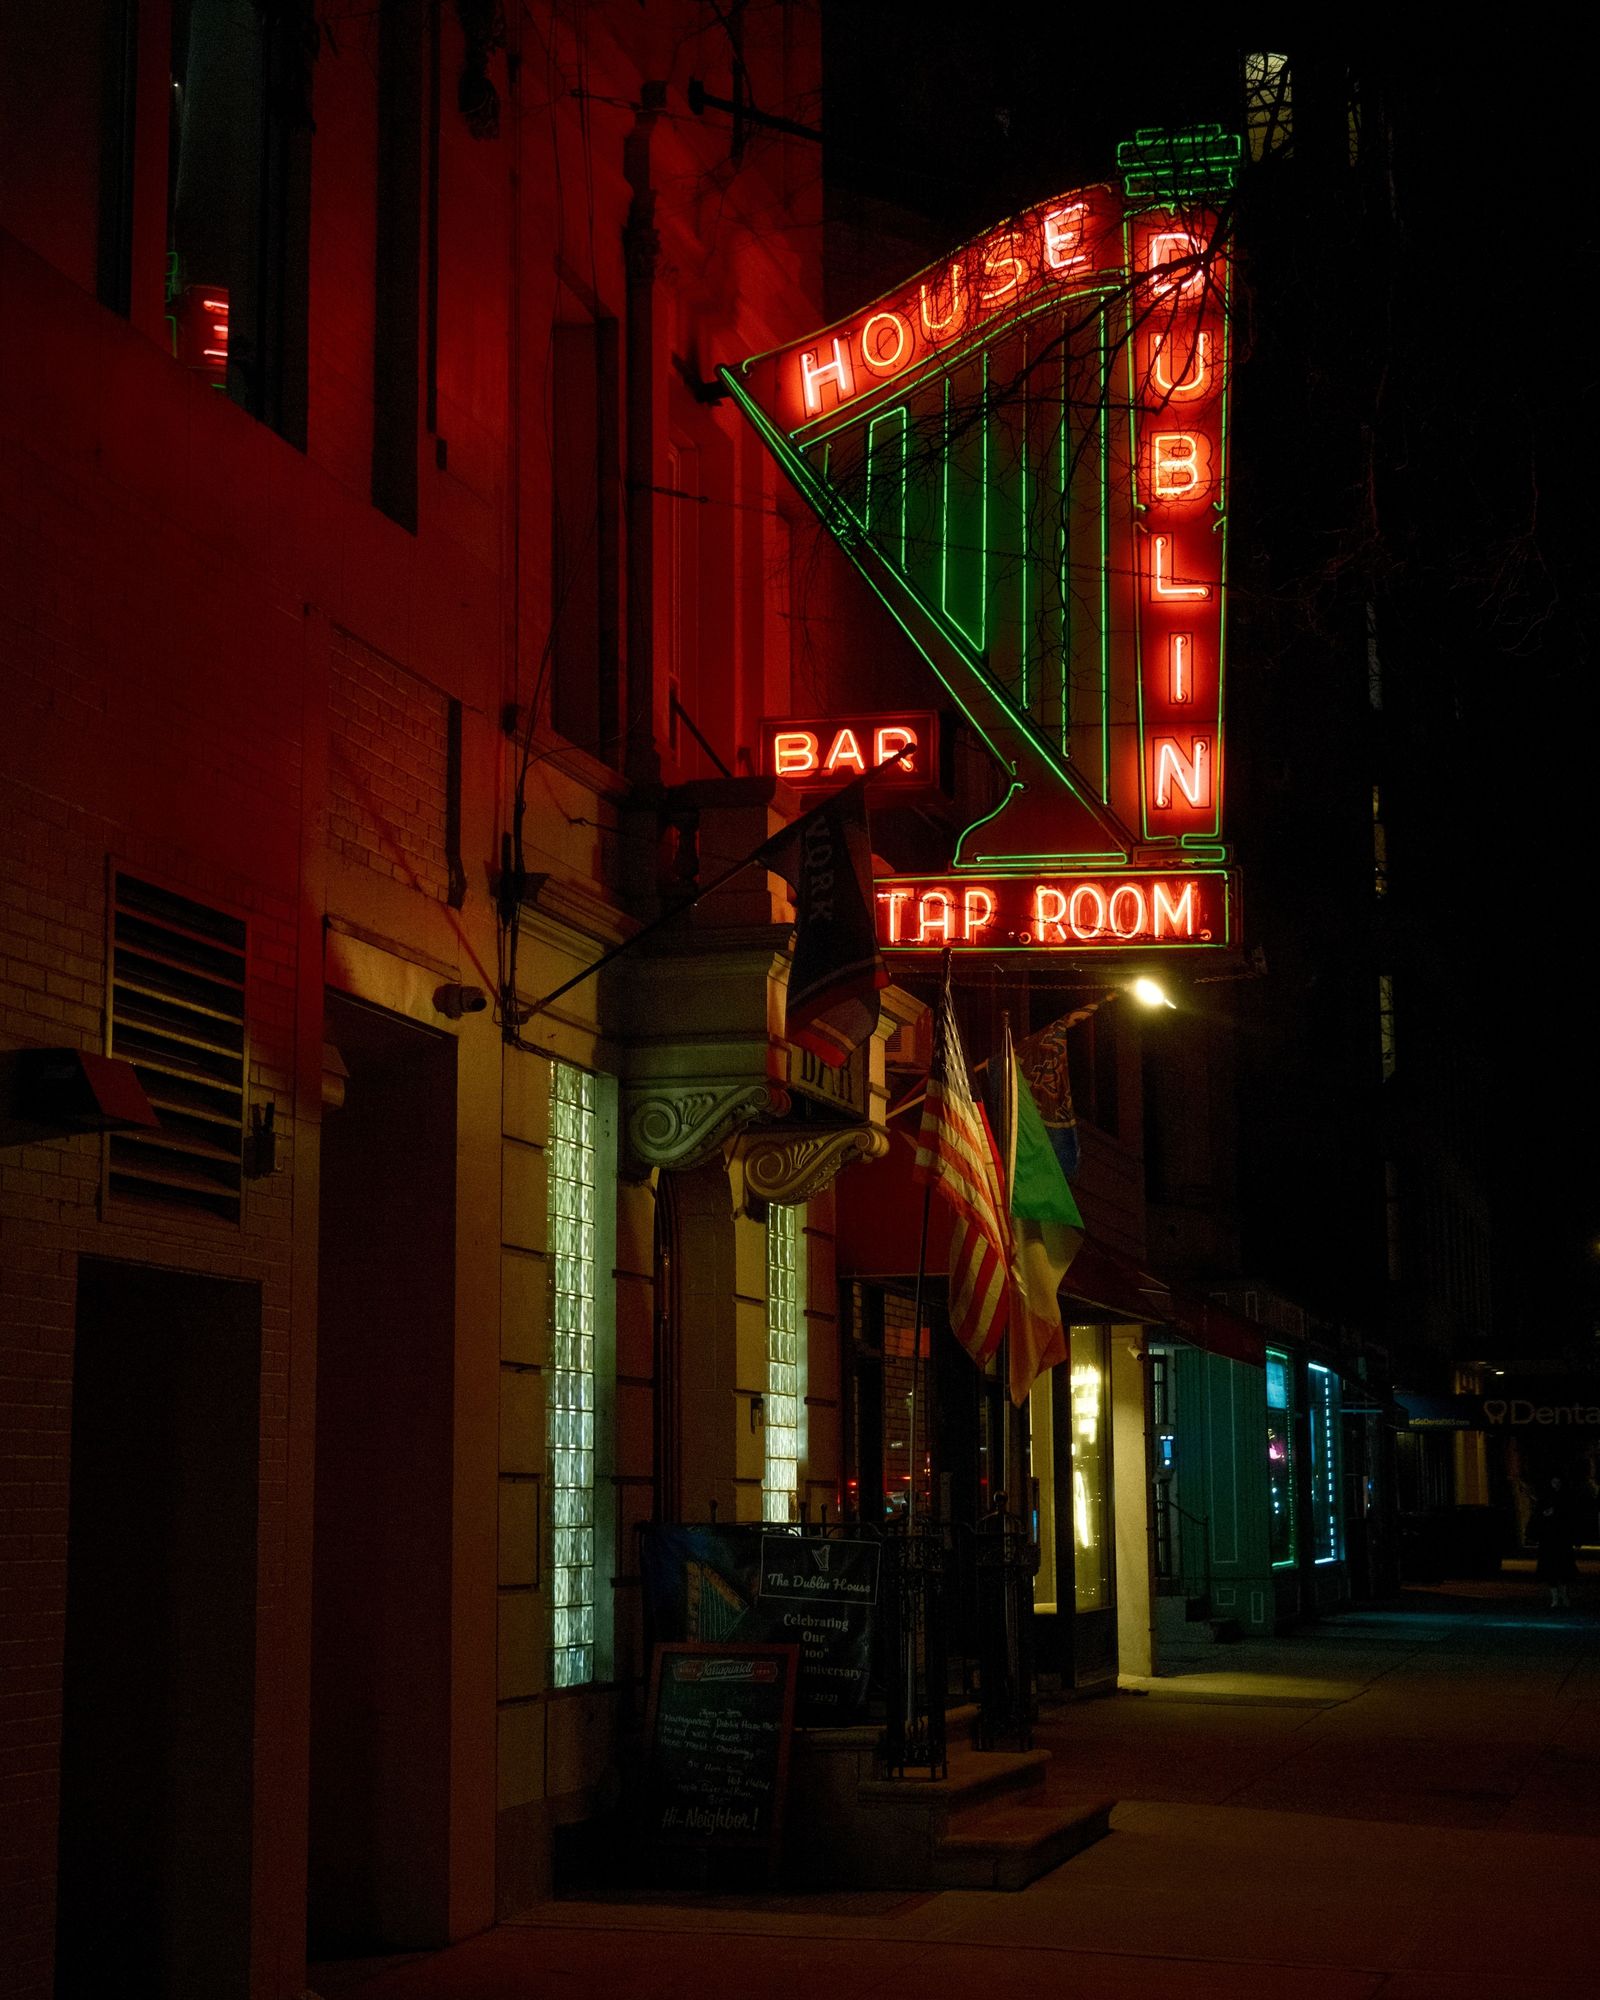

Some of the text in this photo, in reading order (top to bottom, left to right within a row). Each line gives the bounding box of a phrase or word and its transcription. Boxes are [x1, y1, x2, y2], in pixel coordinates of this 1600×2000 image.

[800, 203, 1093, 418] HOUSE
[1150, 231, 1214, 811] DUBLIN
[774, 726, 918, 778] BAR
[876, 881, 1201, 944] TAP ROOM
[1509, 1399, 1600, 1425] Denta
[768, 1572, 872, 1594] The Dublin House
[783, 1613, 849, 1632] Celebrating
[802, 1631, 827, 1644] Our
[801, 1664, 862, 1681] nniversary
